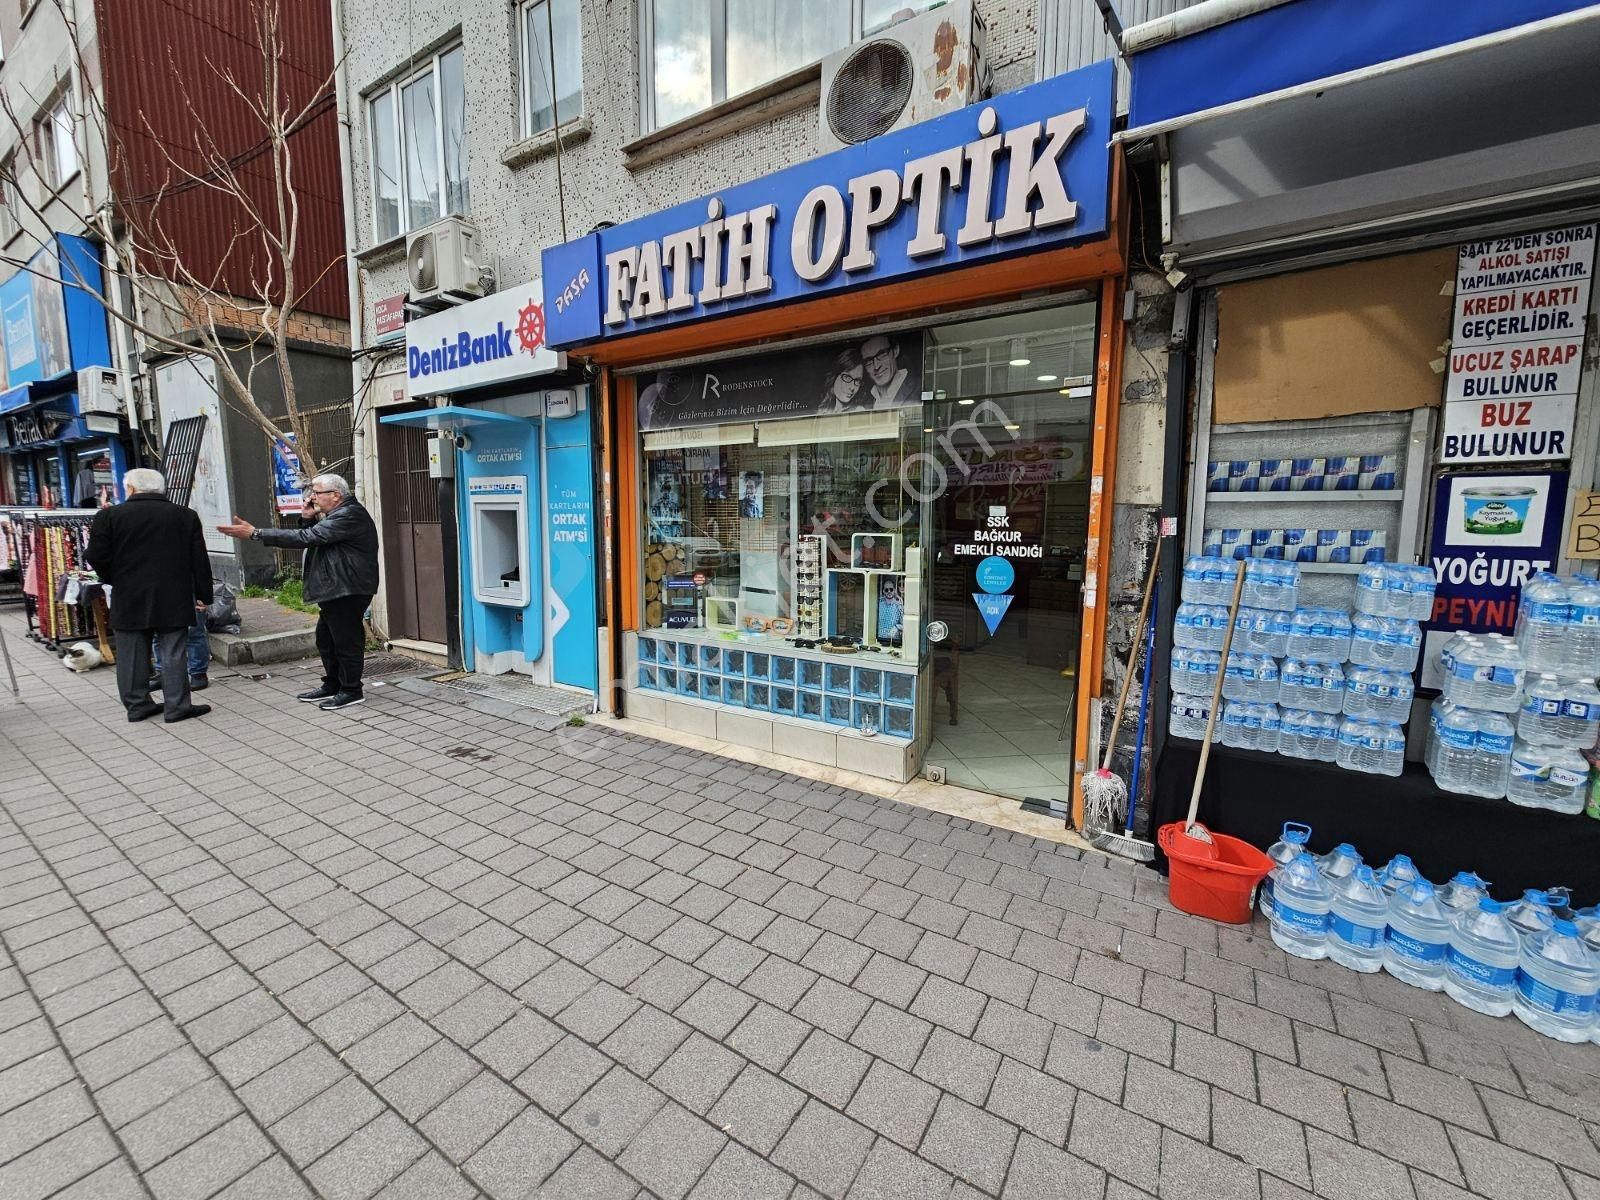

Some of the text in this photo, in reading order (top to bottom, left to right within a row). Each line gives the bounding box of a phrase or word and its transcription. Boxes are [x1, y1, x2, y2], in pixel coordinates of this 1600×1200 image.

[603, 105, 1088, 327] FATİH OPTİK
[1460, 226, 1594, 259] SAAT 22'DEN SONRA
[1478, 245, 1571, 271] ALKOL SATIŞI
[1460, 261, 1588, 290] YAPILMAYACAKTIR.
[1462, 286, 1579, 317] KREDİ KARTI
[1461, 308, 1575, 340] GEÇERLİDİR.
[408, 321, 513, 379] DenizBank
[1451, 344, 1579, 374] UCUZ ŞARAP
[721, 378, 774, 393] RODENSTOCK
[1462, 372, 1559, 397] BULUNUR
[678, 407, 715, 421] Gözleriniz
[716, 406, 738, 418] Bizim
[738, 403, 756, 417] İçin
[1480, 401, 1533, 428] BUZ
[477, 450, 522, 463] ORTAK ATM'Sİ
[1443, 430, 1566, 459] BULUNUR
[550, 501, 590, 510] KARTLARIN
[561, 488, 577, 499] TÜM
[552, 514, 586, 525] ORTAK
[987, 516, 1010, 528] SSK
[553, 528, 588, 543] ATM'Sİ
[974, 529, 1022, 542] BAĞKUR
[954, 542, 1043, 559] EMEKLİ SANDIĞI
[668, 616, 697, 624] ACUVUE
[1431, 594, 1518, 628] PEYNİ
[1390, 931, 1425, 954] buzdağı
[1453, 954, 1491, 978] buzdağı
